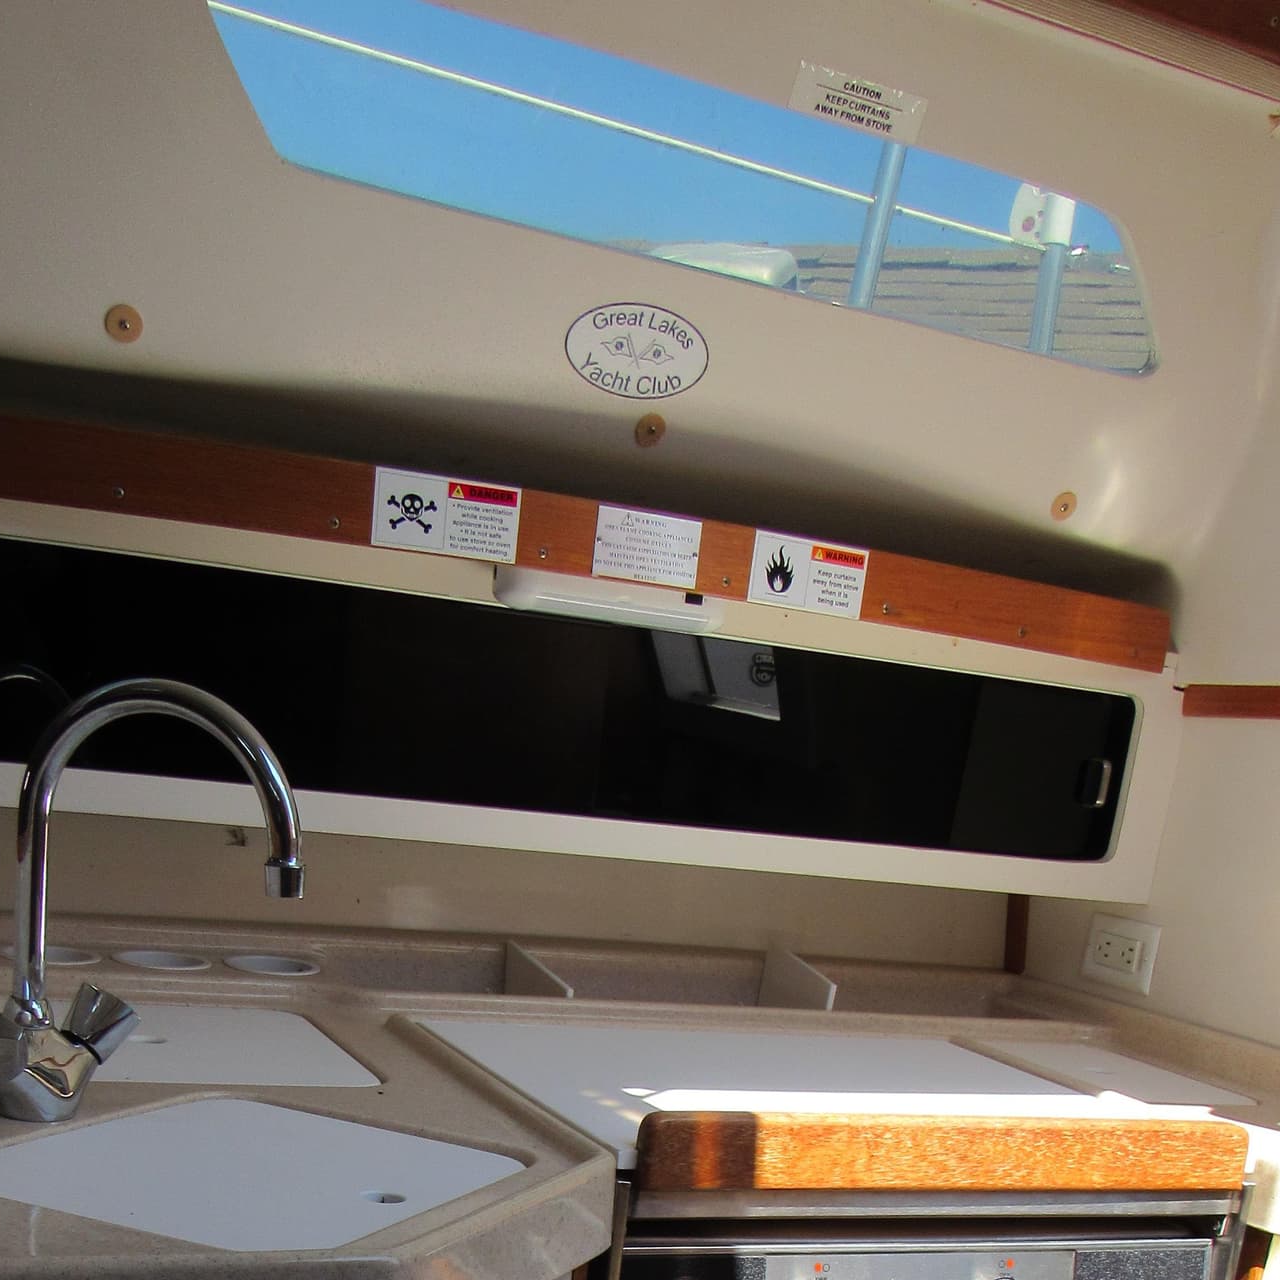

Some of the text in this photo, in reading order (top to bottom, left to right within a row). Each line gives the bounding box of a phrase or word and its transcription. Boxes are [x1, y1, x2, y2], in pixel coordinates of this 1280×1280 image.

[843, 81, 882, 101] CAUTION
[824, 93, 891, 120] KEEP CURTAINS
[814, 103, 892, 133] AWAY FROM STOVE
[592, 311, 694, 350] Great Lakes
[580, 352, 682, 395] Yacht Club
[469, 488, 514, 501] DANGER
[457, 503, 513, 516] Provide ventilation
[452, 520, 481, 528] appliance
[479, 514, 503, 524] cooking
[485, 546, 508, 557] heating
[825, 551, 864, 566] WARNING
[817, 569, 857, 582] Keep curtains
[813, 578, 828, 587] away
[828, 579, 842, 588] from
[817, 596, 849, 608] being used
